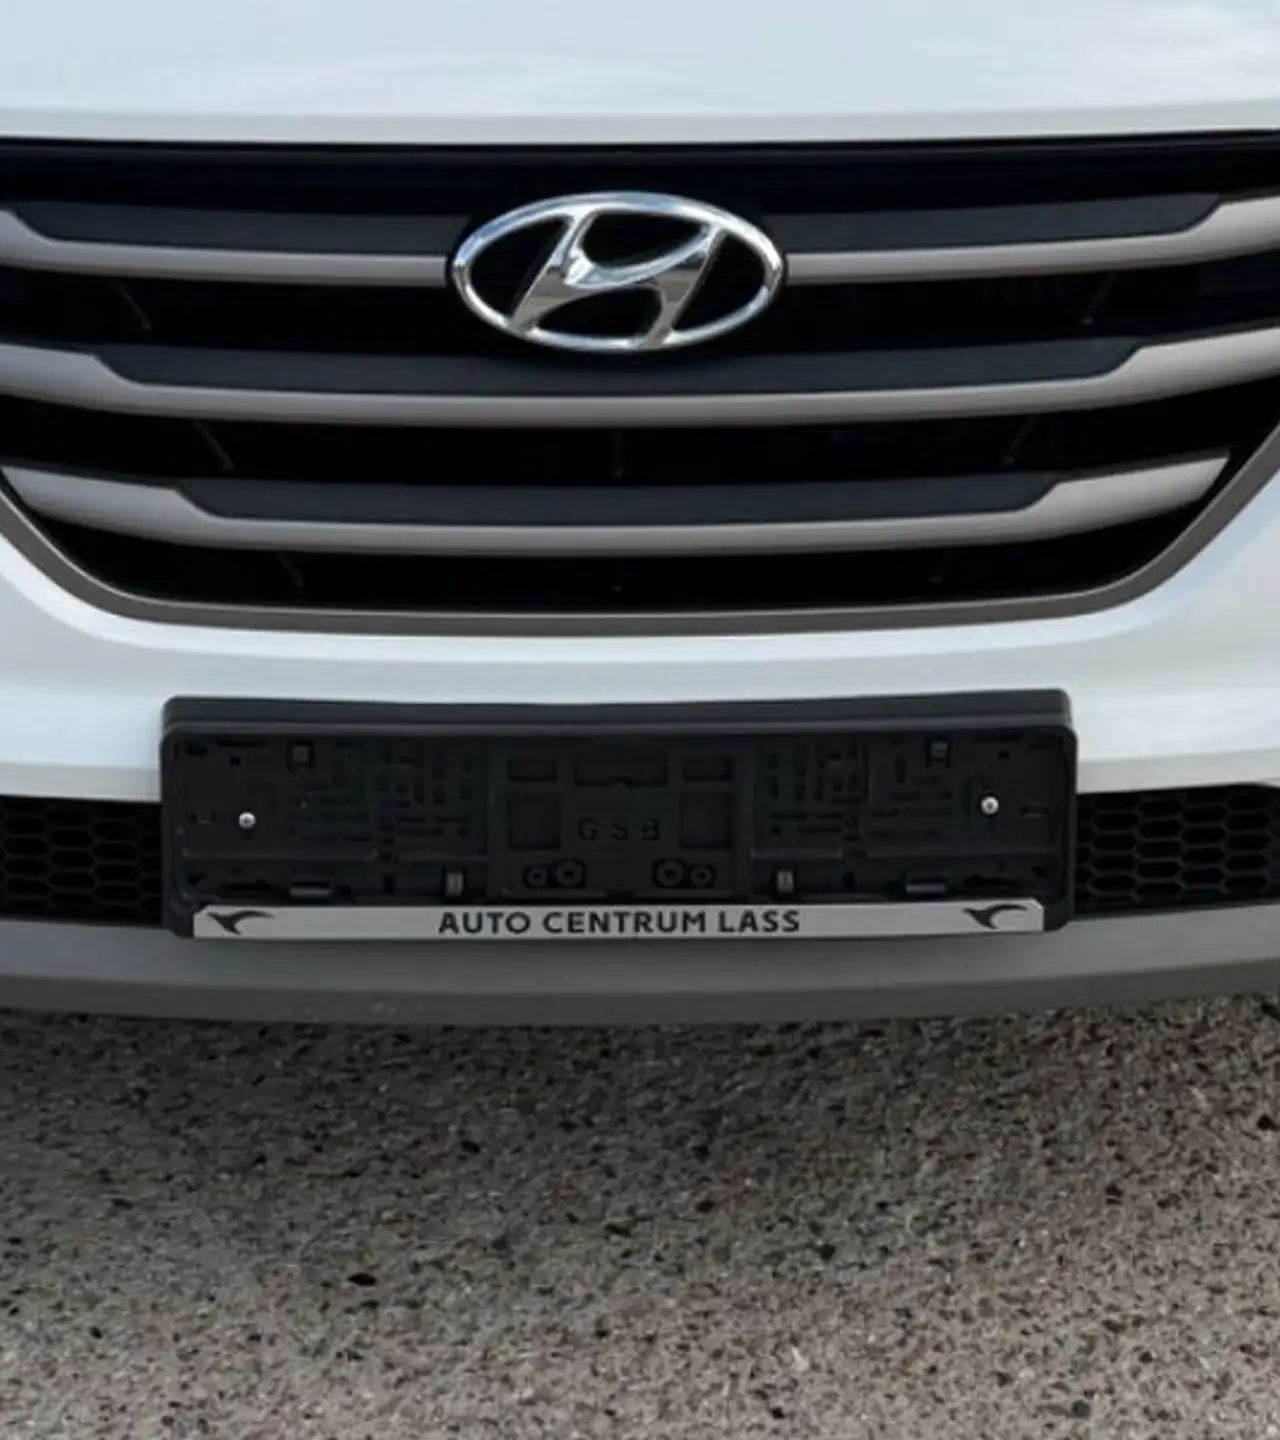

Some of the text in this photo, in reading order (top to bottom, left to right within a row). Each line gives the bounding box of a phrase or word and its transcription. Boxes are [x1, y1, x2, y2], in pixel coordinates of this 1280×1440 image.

[437, 909, 802, 935] AUTO CENTRUM LASS
